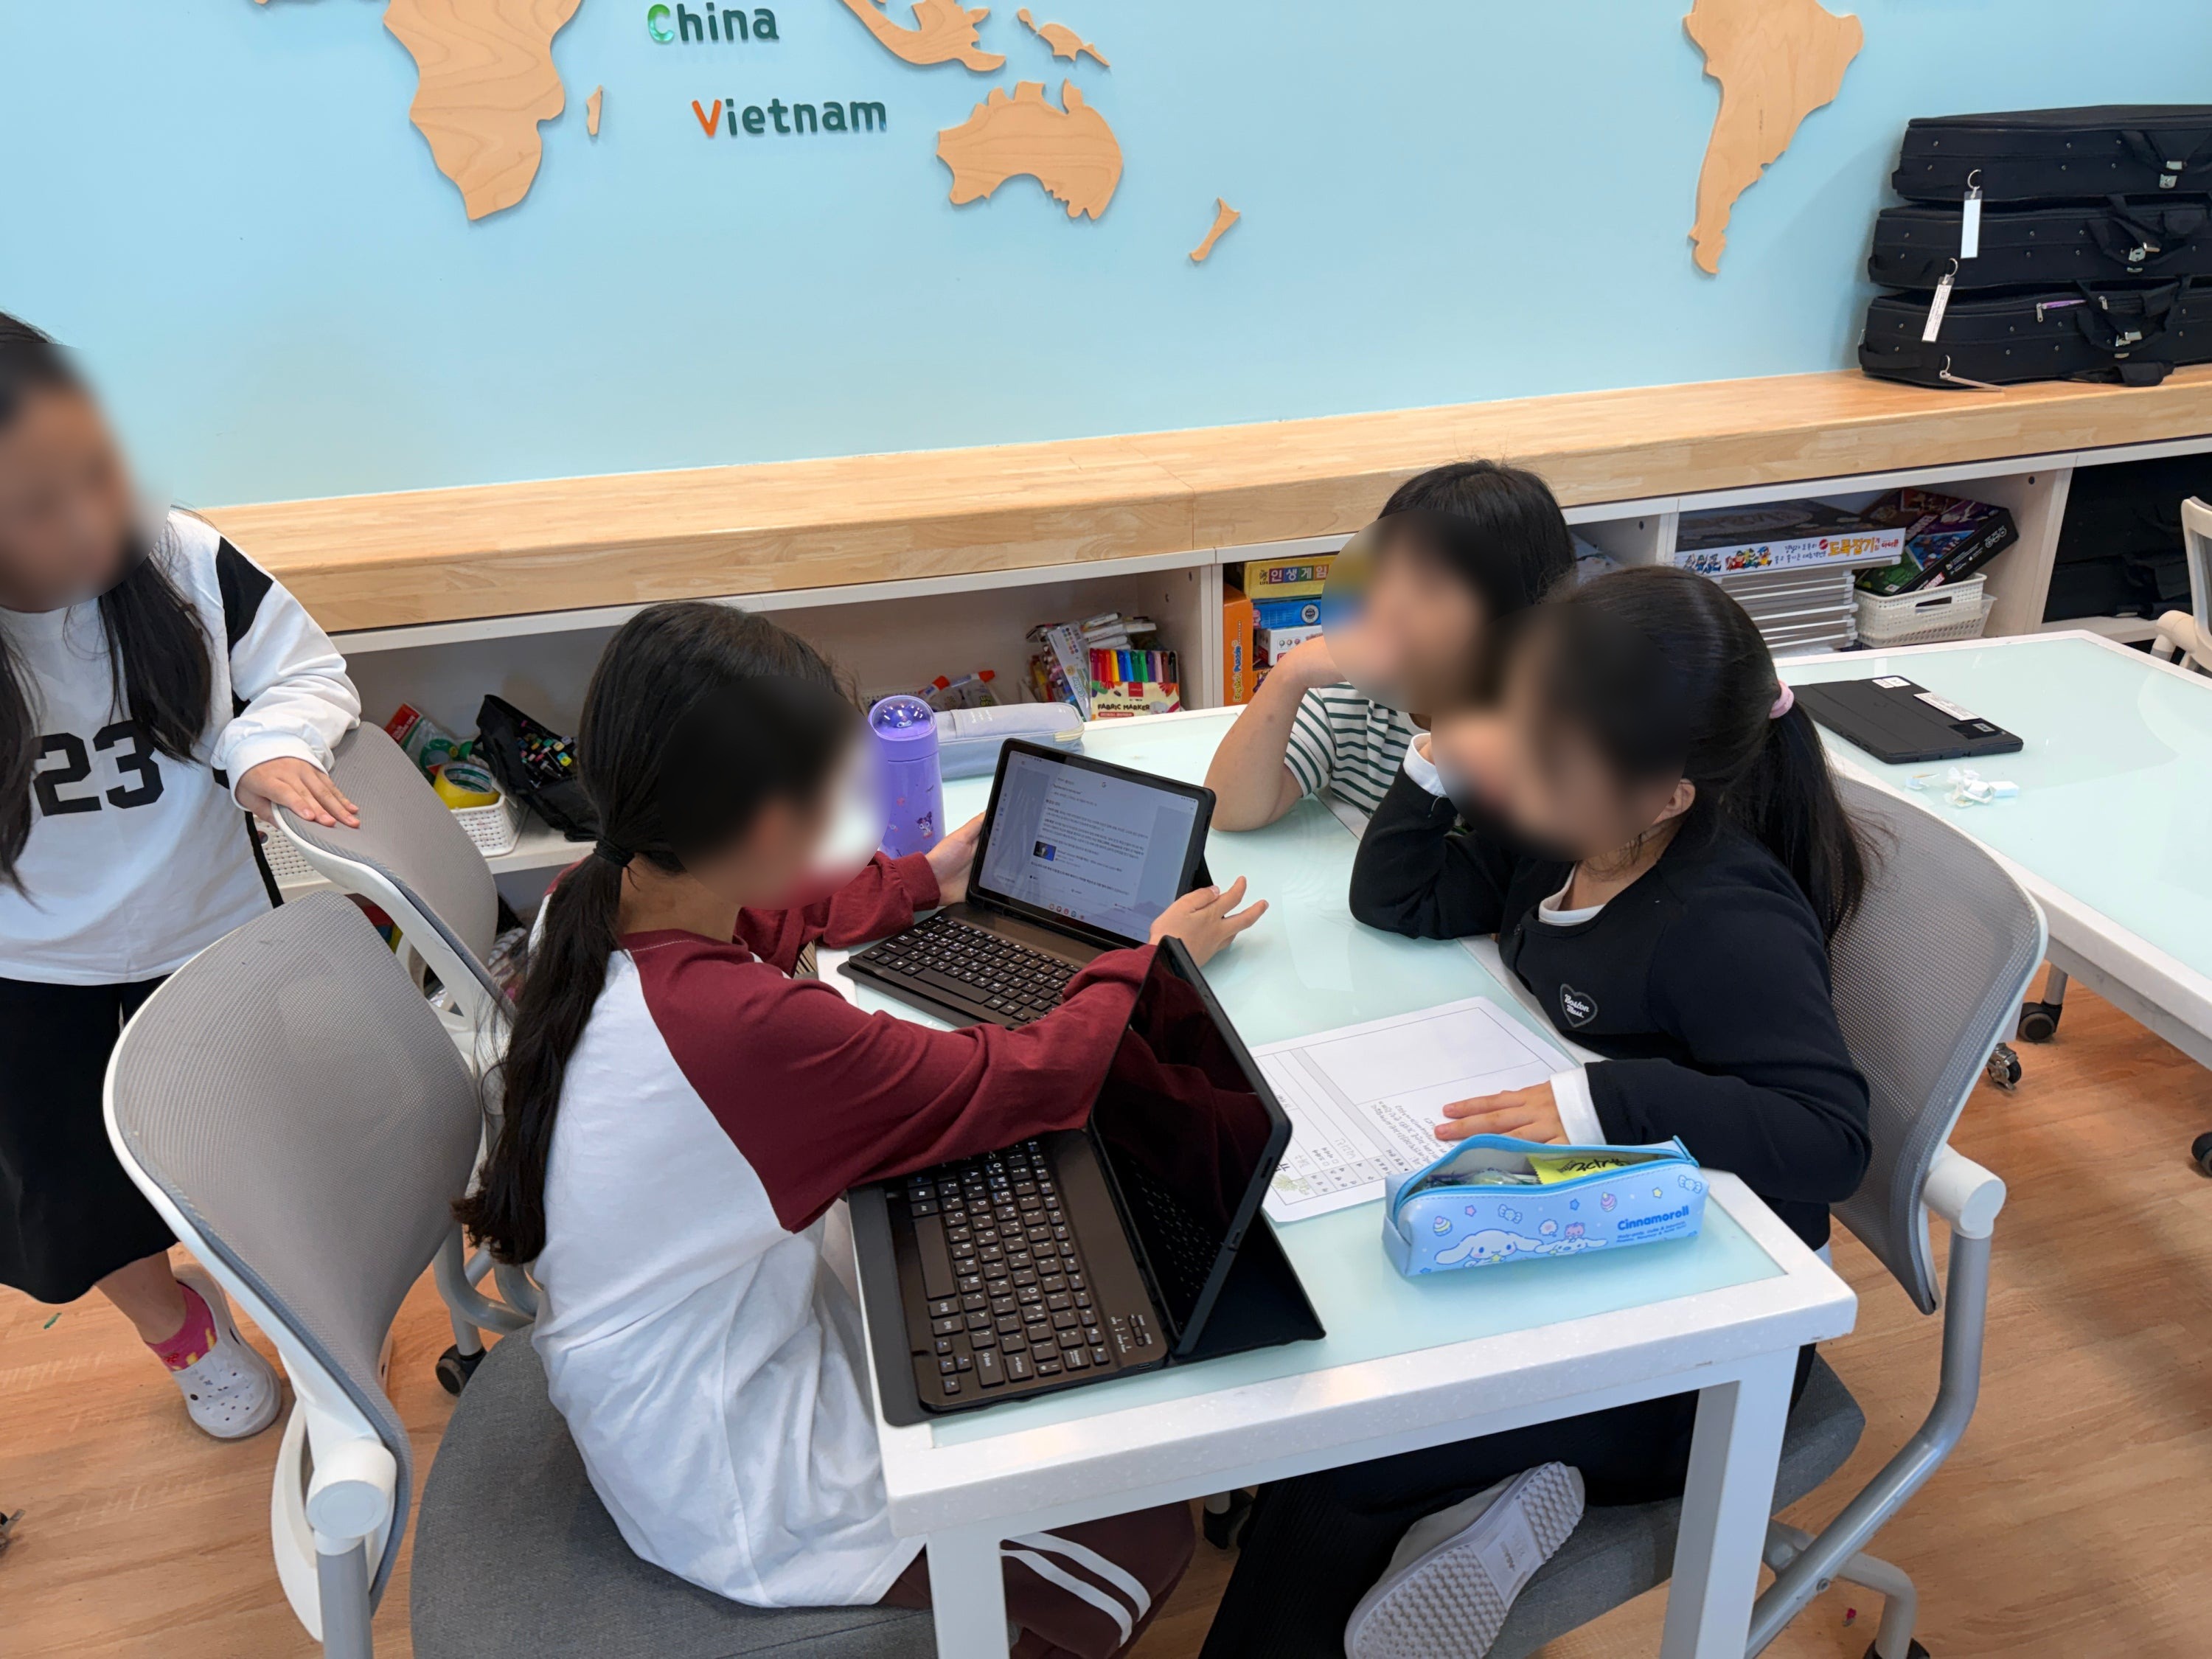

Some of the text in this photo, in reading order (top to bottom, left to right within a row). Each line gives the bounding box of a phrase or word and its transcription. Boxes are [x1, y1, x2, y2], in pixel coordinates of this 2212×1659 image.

[647, 2, 779, 43] China
[692, 98, 887, 137] Vietnam
[1828, 537, 1875, 557] 도둑잡기
[1270, 566, 1327, 582] 인생게임
[33, 720, 164, 816] 23
[1565, 994, 1590, 1012] Boston
[1618, 1205, 1689, 1231] Cinnamoroll
